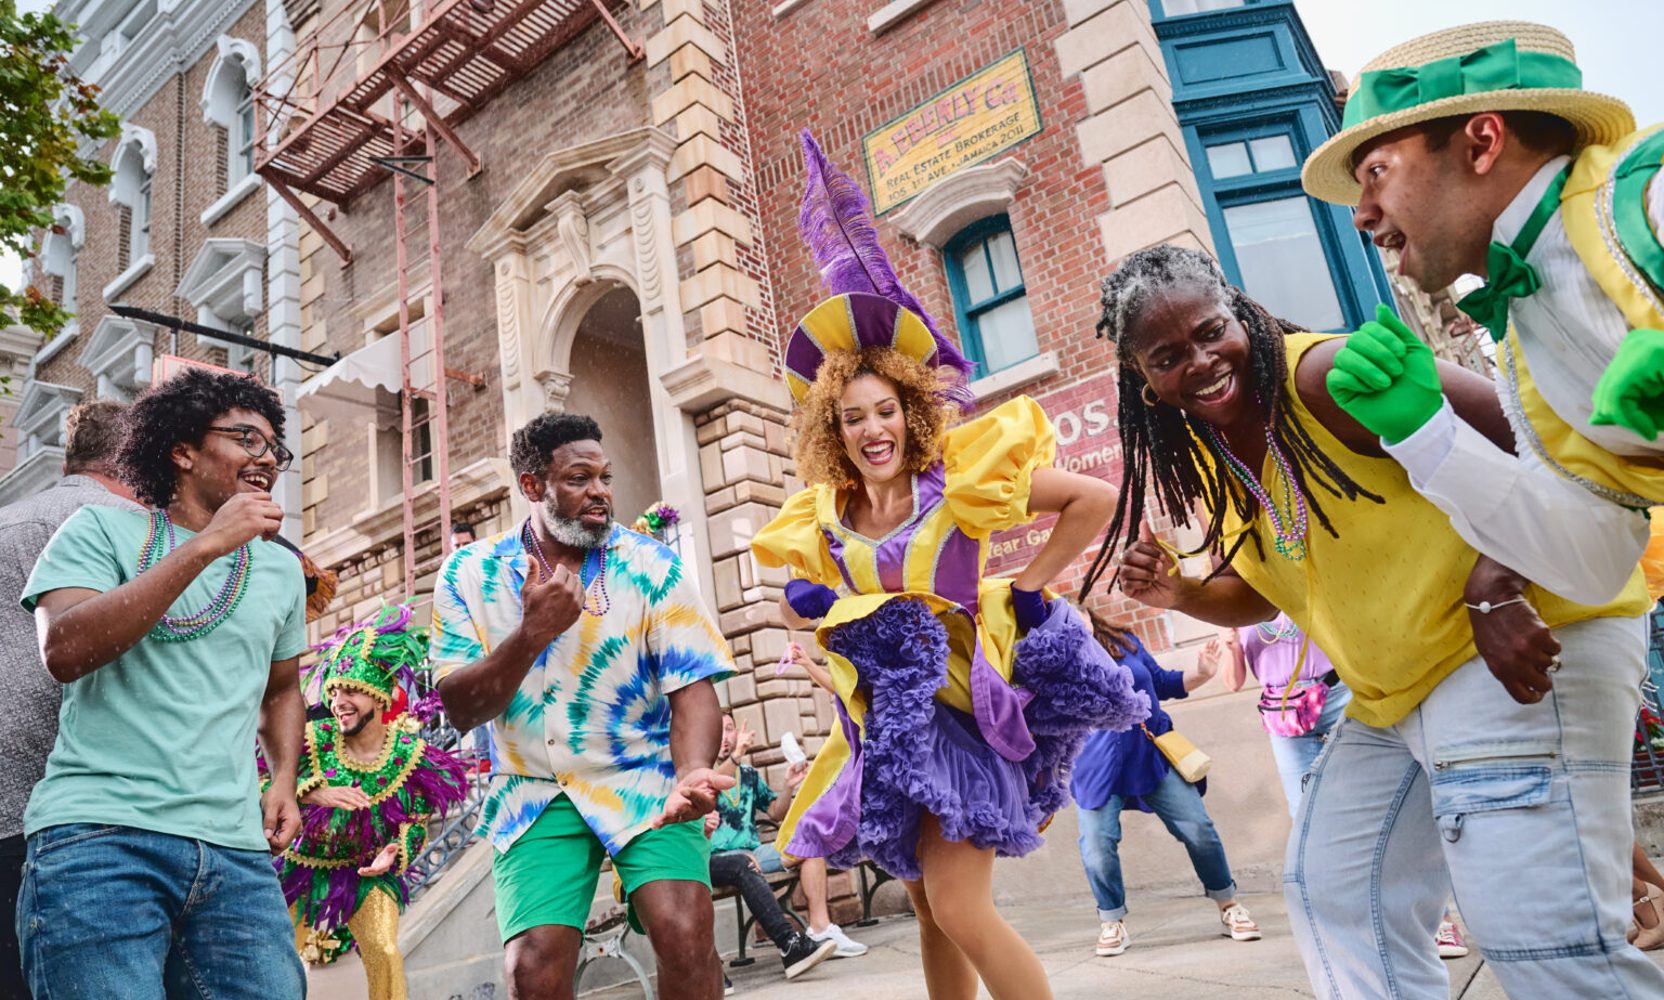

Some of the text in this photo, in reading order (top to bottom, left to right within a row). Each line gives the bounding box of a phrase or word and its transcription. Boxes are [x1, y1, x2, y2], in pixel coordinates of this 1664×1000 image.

[890, 84, 981, 156] EBERLY
[957, 141, 999, 167] JAMAICA
[1000, 124, 1024, 146] 2011
[886, 171, 911, 189] REAL
[913, 150, 951, 175] ESTATE
[955, 112, 1020, 153] BROKERAGE
[1027, 527, 1054, 546] Ga
